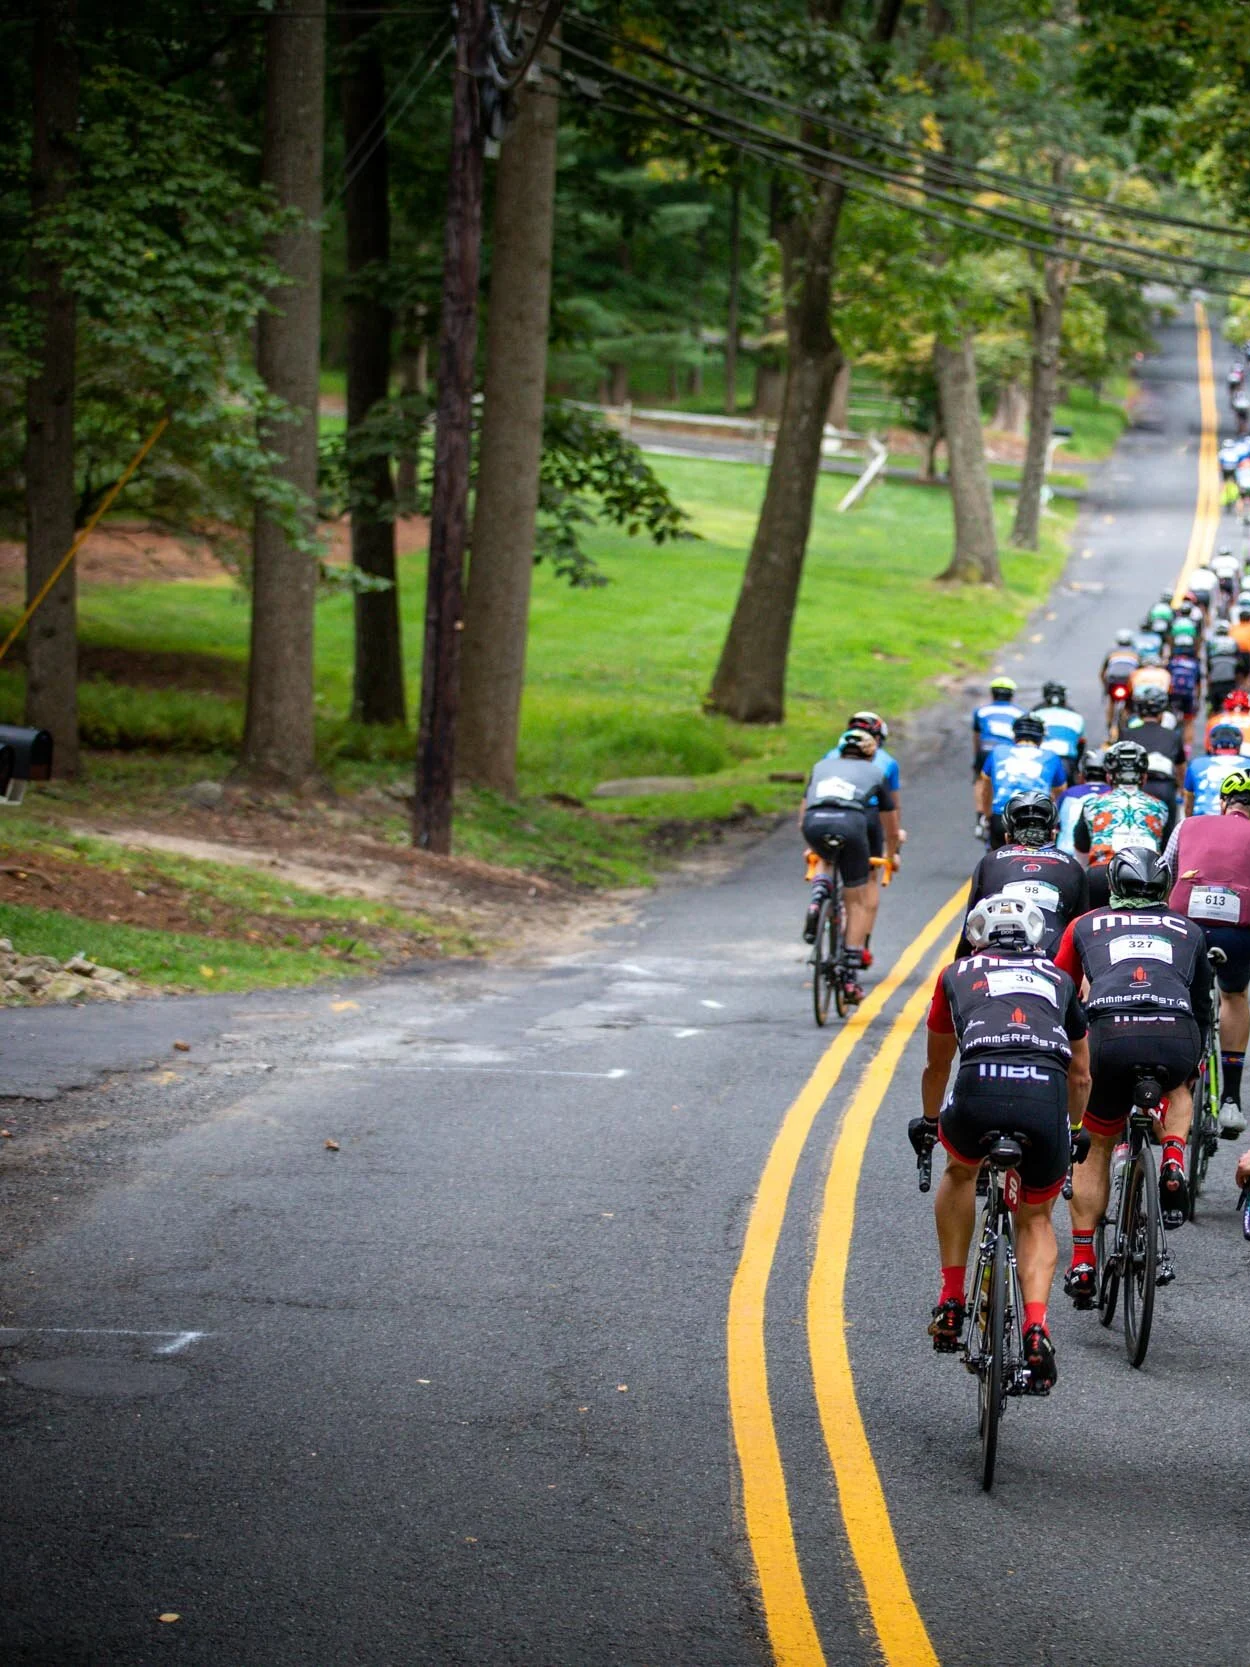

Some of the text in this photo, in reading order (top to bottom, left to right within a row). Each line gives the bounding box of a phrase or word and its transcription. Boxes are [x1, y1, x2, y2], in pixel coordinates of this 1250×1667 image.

[1024, 886, 1039, 894] 98
[1205, 895, 1226, 907] 613
[1092, 914, 1188, 935] MBC
[1128, 940, 1153, 949] 327
[957, 954, 1062, 981] MBC
[1015, 974, 1034, 984] 30
[1088, 993, 1175, 1008] HAMMERFEST
[965, 1033, 1058, 1049] HAMMERFEST
[1009, 1176, 1018, 1205] 30
